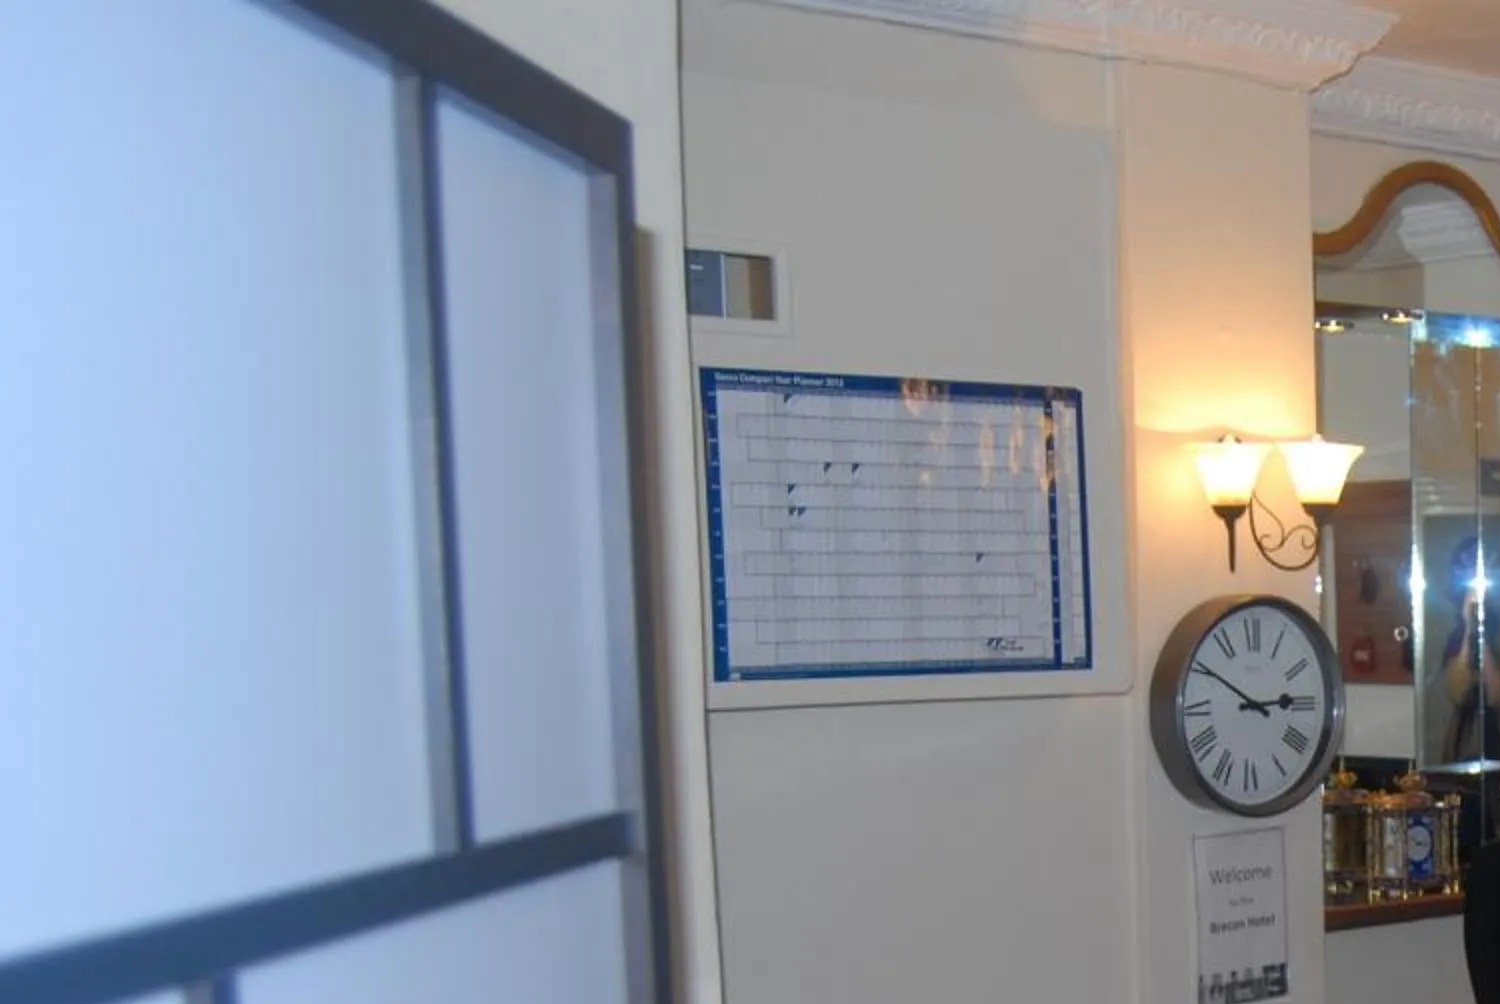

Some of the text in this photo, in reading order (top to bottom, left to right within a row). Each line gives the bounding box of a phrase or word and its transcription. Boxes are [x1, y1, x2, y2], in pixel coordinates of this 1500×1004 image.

[1209, 864, 1274, 885] Welcome
[1241, 895, 1256, 906] the
[1247, 911, 1276, 928] Hotel
